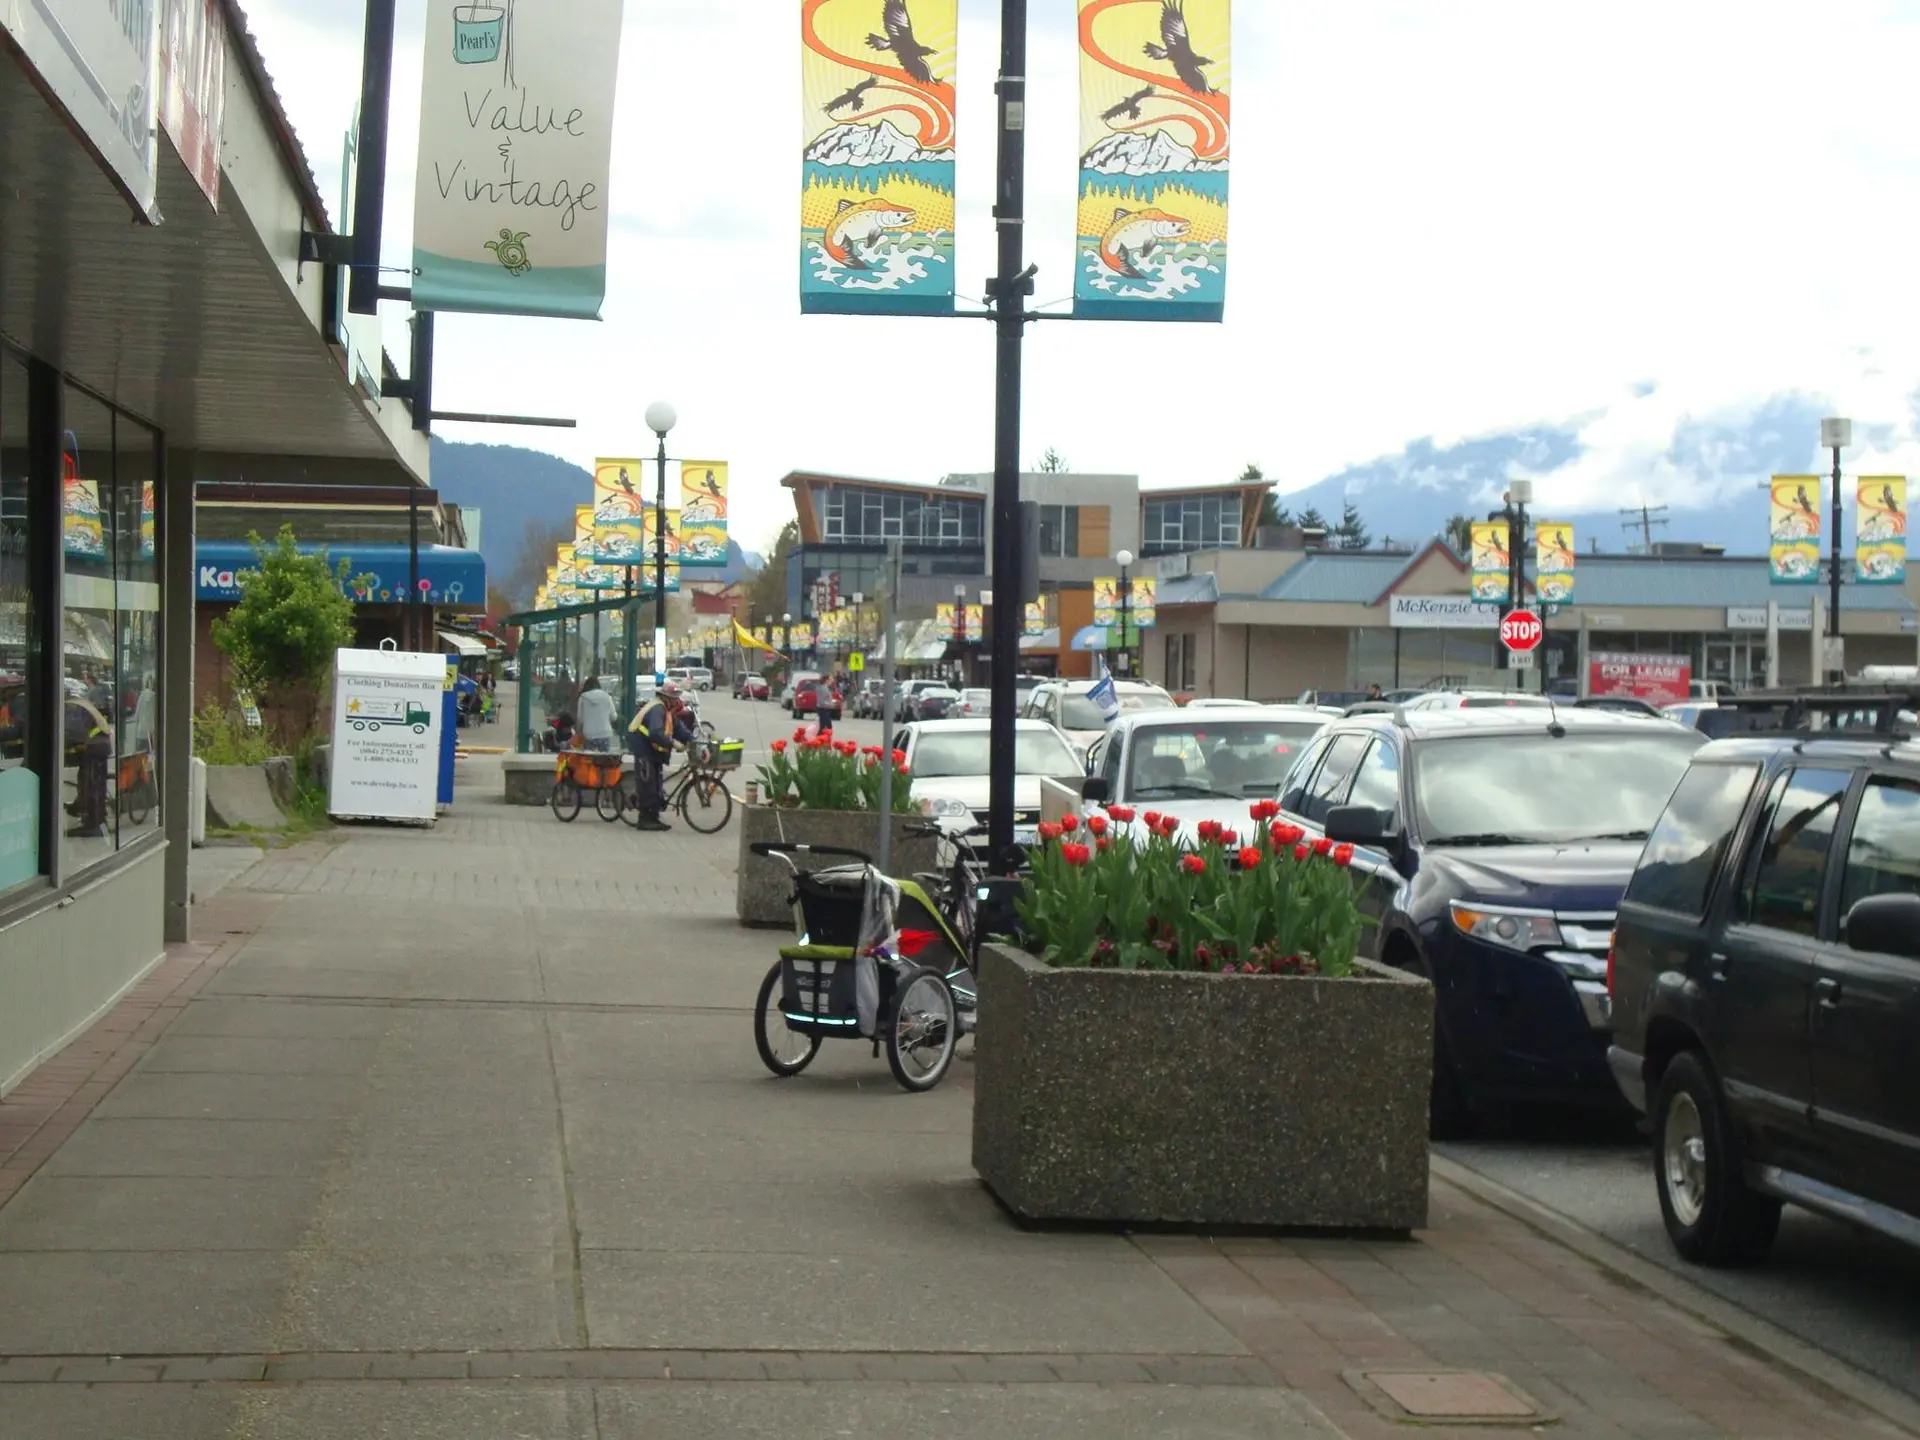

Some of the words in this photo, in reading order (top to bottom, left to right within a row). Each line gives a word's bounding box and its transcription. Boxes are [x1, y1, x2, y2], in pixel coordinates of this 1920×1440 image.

[460, 32, 496, 50] Pearl's
[464, 86, 585, 137] Value
[435, 159, 598, 231] Vintage
[1396, 599, 1472, 614] McKenzie
[1502, 621, 1540, 640] STOP
[1517, 656, 1532, 665] WAY
[1602, 664, 1630, 675] FOR
[1637, 665, 1678, 677] LEASE
[347, 678, 381, 688] Clothing
[384, 680, 420, 689] Donation
[421, 682, 436, 690] Bin
[362, 740, 407, 748] Information
